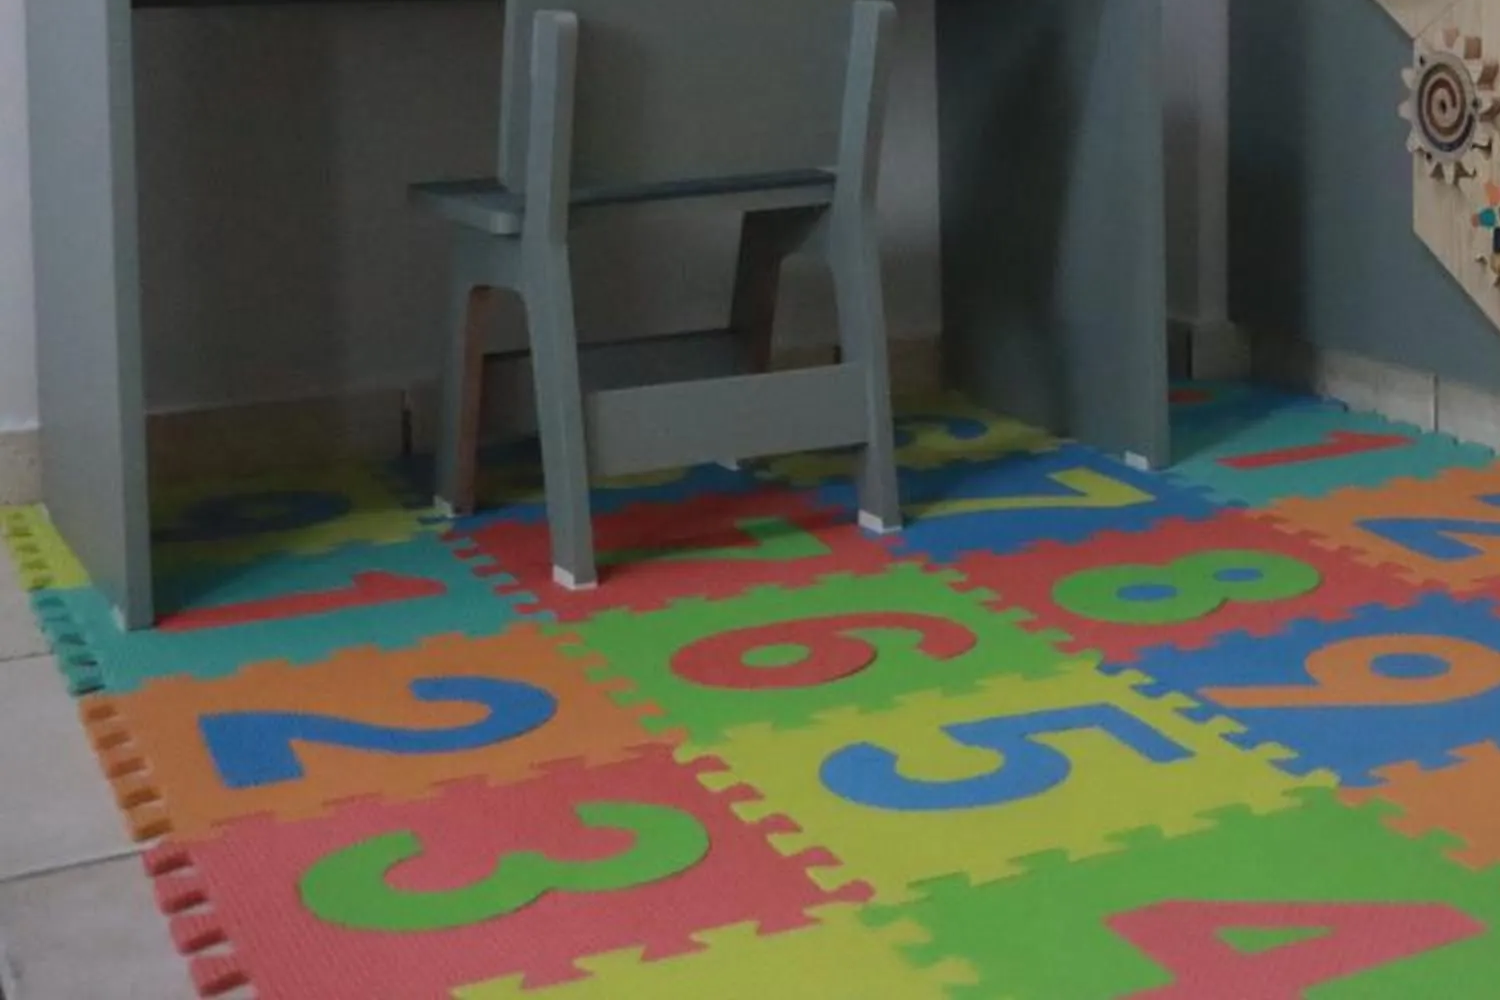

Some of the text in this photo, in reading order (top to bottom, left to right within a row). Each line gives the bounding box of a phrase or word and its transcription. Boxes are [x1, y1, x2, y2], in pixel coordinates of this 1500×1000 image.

[1216, 430, 1414, 469] 1
[905, 467, 1156, 517] 7
[153, 570, 447, 630] 1
[1053, 549, 1321, 624] 8
[669, 611, 979, 695] 6
[200, 676, 557, 789] 2
[819, 703, 1197, 811] 5
[301, 802, 710, 931] 3
[1104, 898, 1488, 1000] 4
